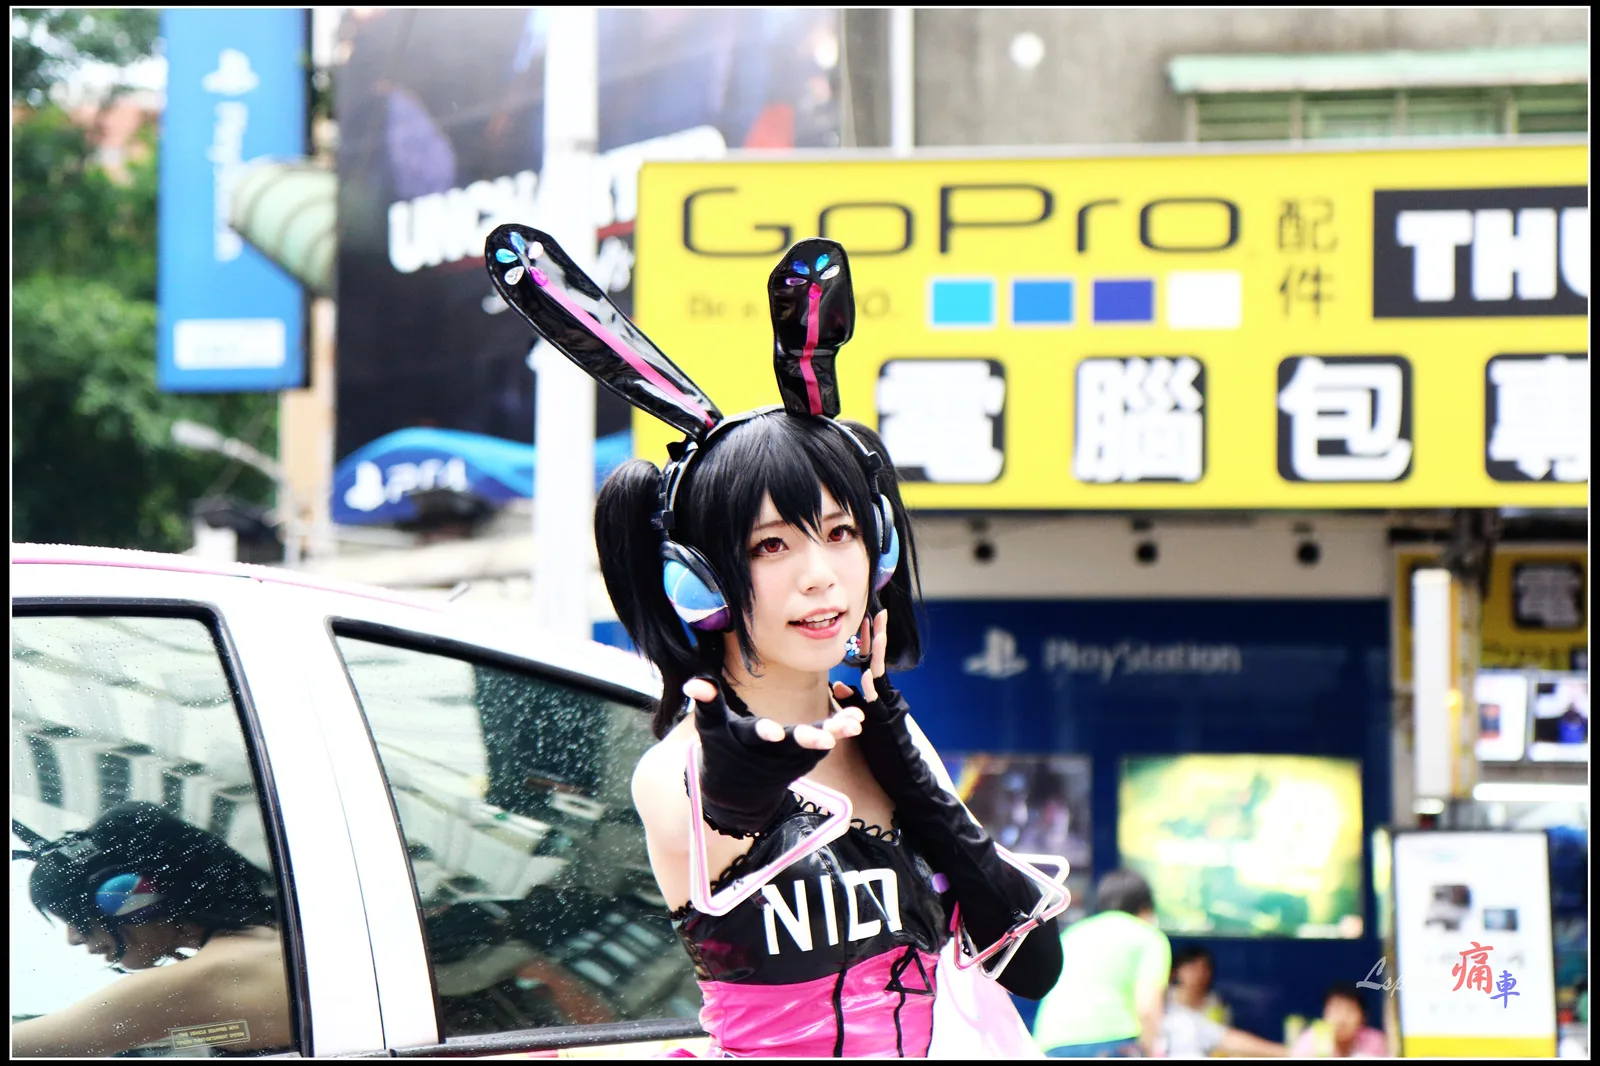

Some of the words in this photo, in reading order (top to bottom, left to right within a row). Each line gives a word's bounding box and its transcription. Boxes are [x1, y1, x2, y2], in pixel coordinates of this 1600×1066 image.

[683, 182, 1241, 258] GoPro
[1277, 198, 1338, 322] 配件
[1043, 638, 1242, 683] PlayStation
